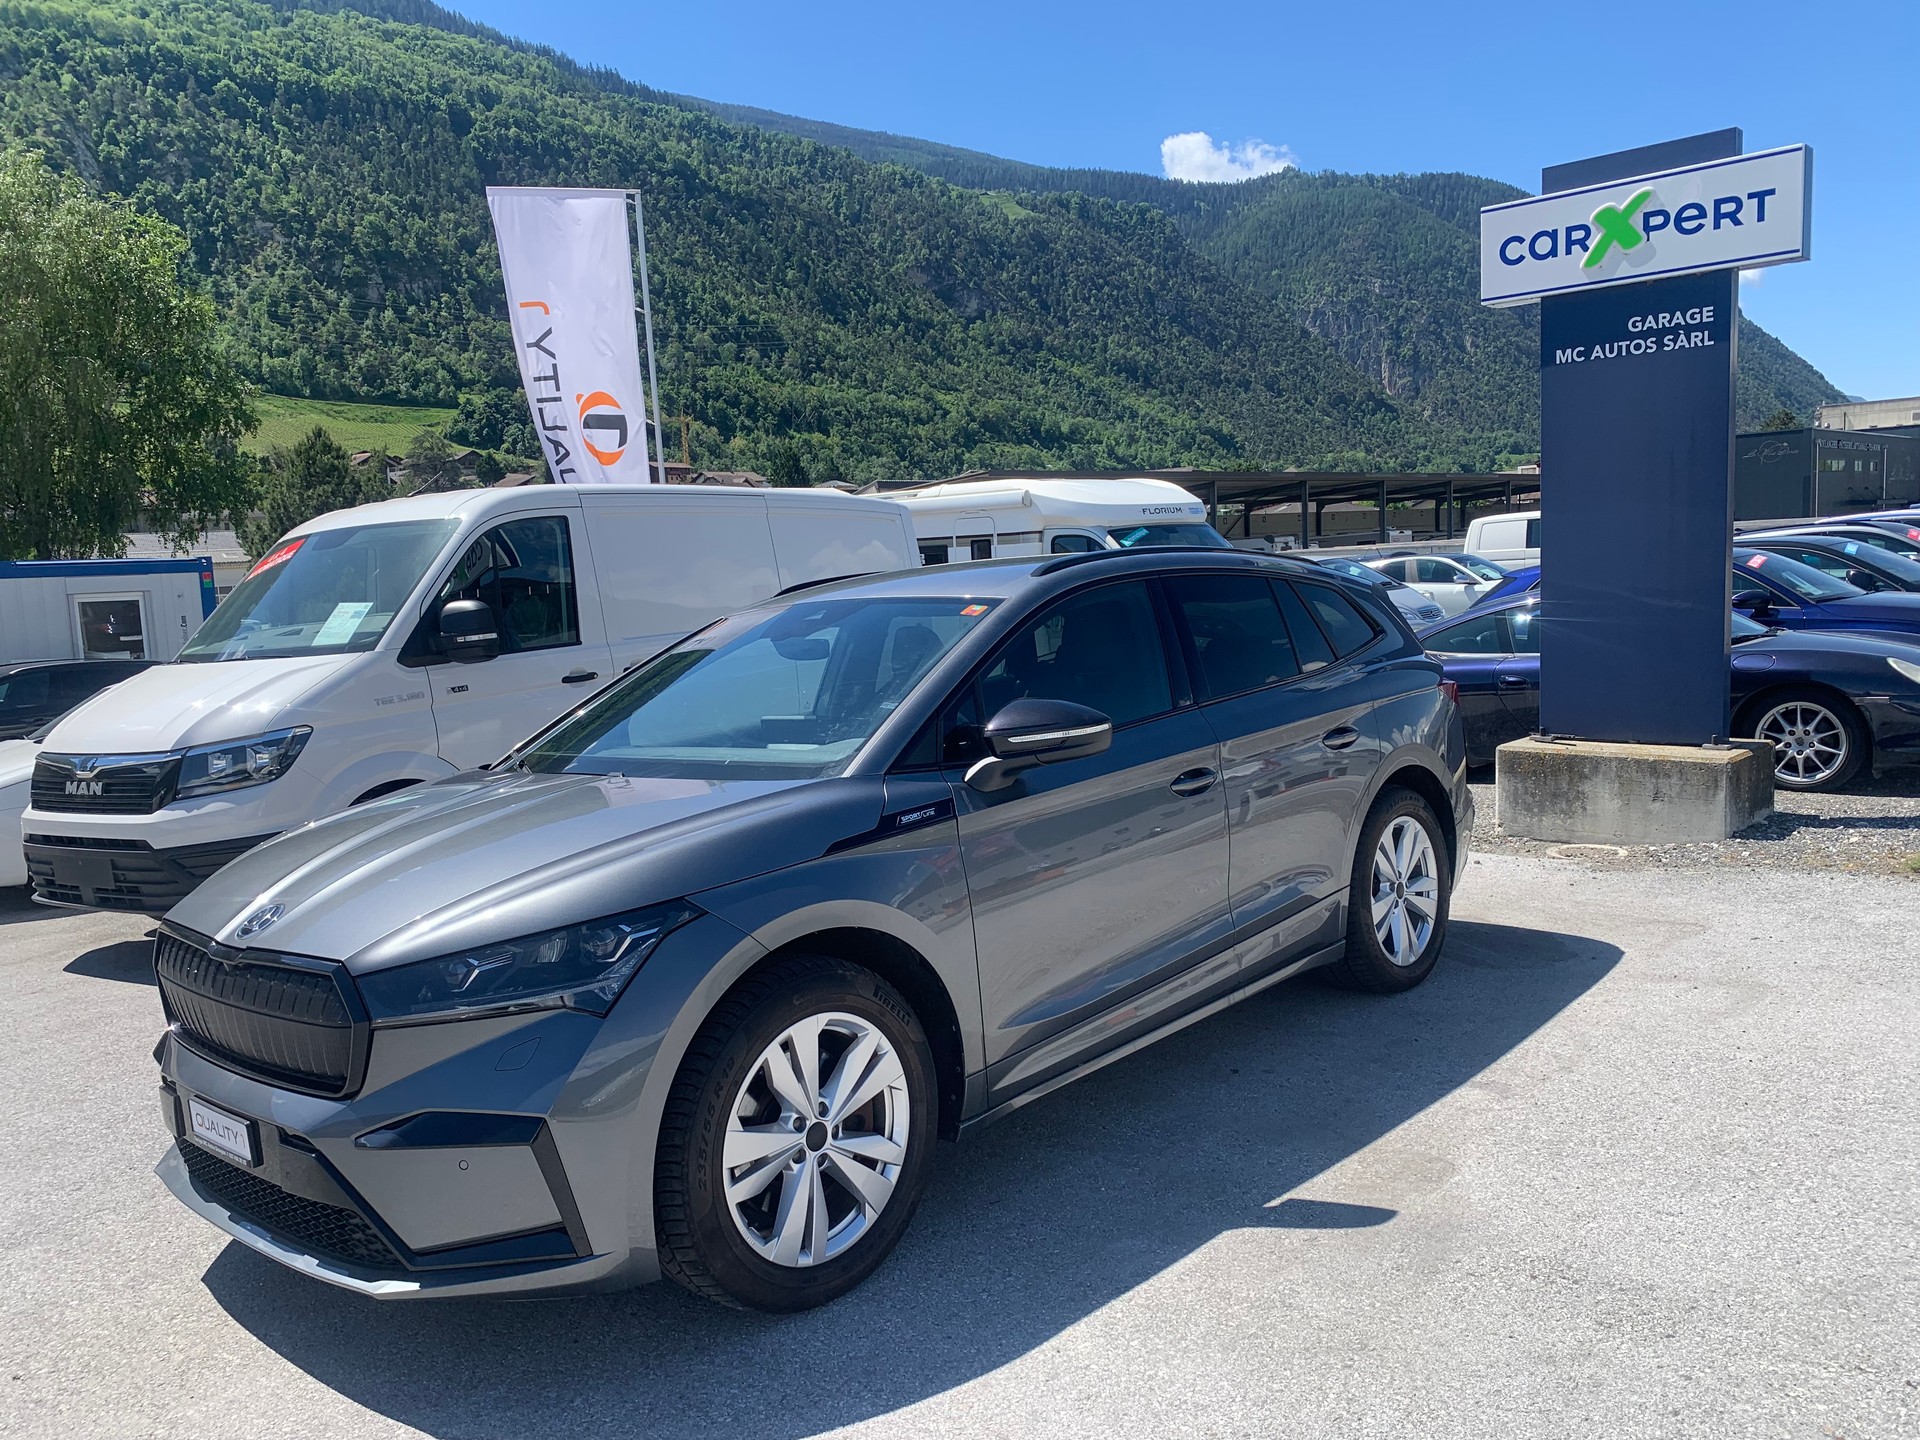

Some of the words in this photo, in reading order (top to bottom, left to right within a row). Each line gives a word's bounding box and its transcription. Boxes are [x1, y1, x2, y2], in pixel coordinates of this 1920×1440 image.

[1627, 306, 1714, 332] GARAGE
[1555, 347, 1585, 364] MC
[1590, 337, 1657, 361] AUTOS
[1663, 330, 1715, 351] SÀRL
[1142, 507, 1183, 515] FLORIUM
[65, 781, 103, 796] MAN
[873, 985, 911, 1026] PIRELLI
[195, 1112, 238, 1145] QUALITY
